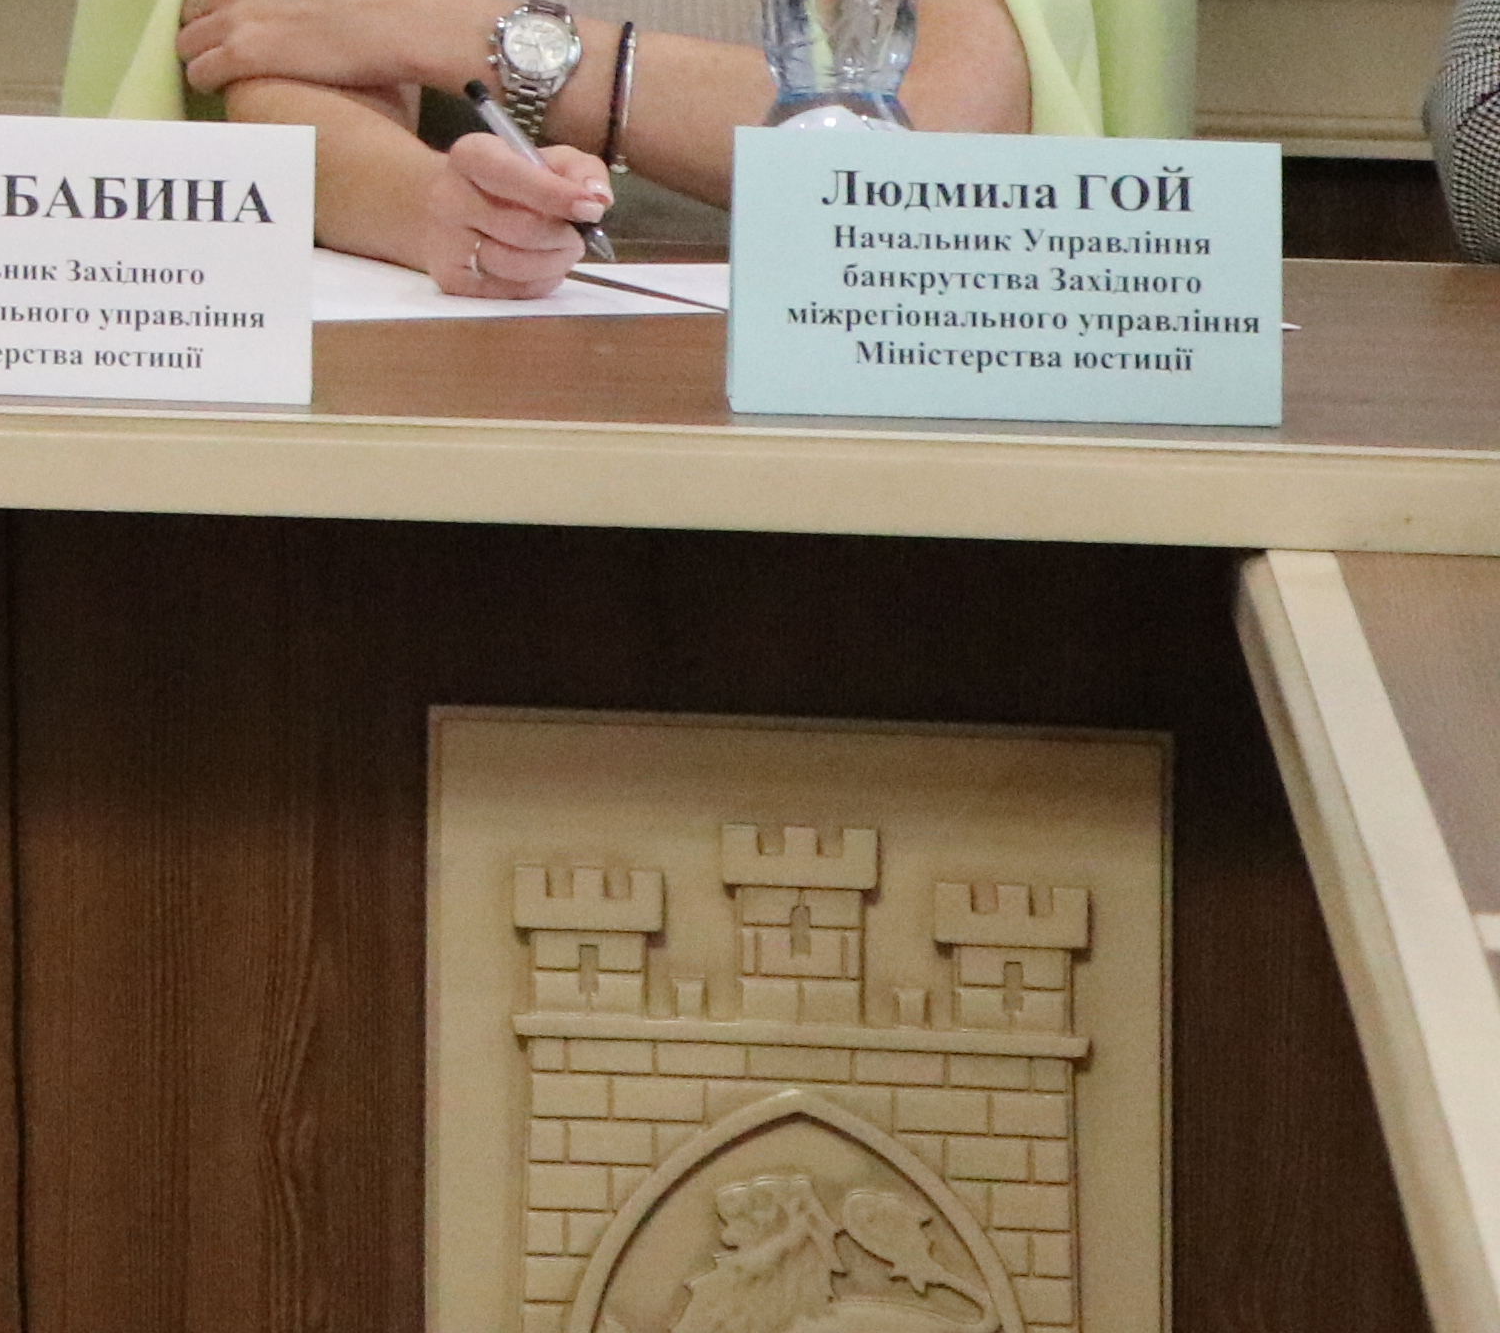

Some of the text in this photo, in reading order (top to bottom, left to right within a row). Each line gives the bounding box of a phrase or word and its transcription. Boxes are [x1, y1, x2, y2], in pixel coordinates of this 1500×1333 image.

[4, 174, 273, 224] БАБИНА
[821, 166, 1191, 212] Людмила ГОЙ
[835, 225, 1210, 260] Начальник Управління
[65, 259, 205, 284] Західного
[843, 263, 1202, 296] банкрутства Західного
[99, 305, 264, 332] управління
[788, 301, 1259, 338] міжрегіонального управління
[94, 346, 203, 369] юстиції
[857, 340, 1193, 374] Міністерства юстиції
